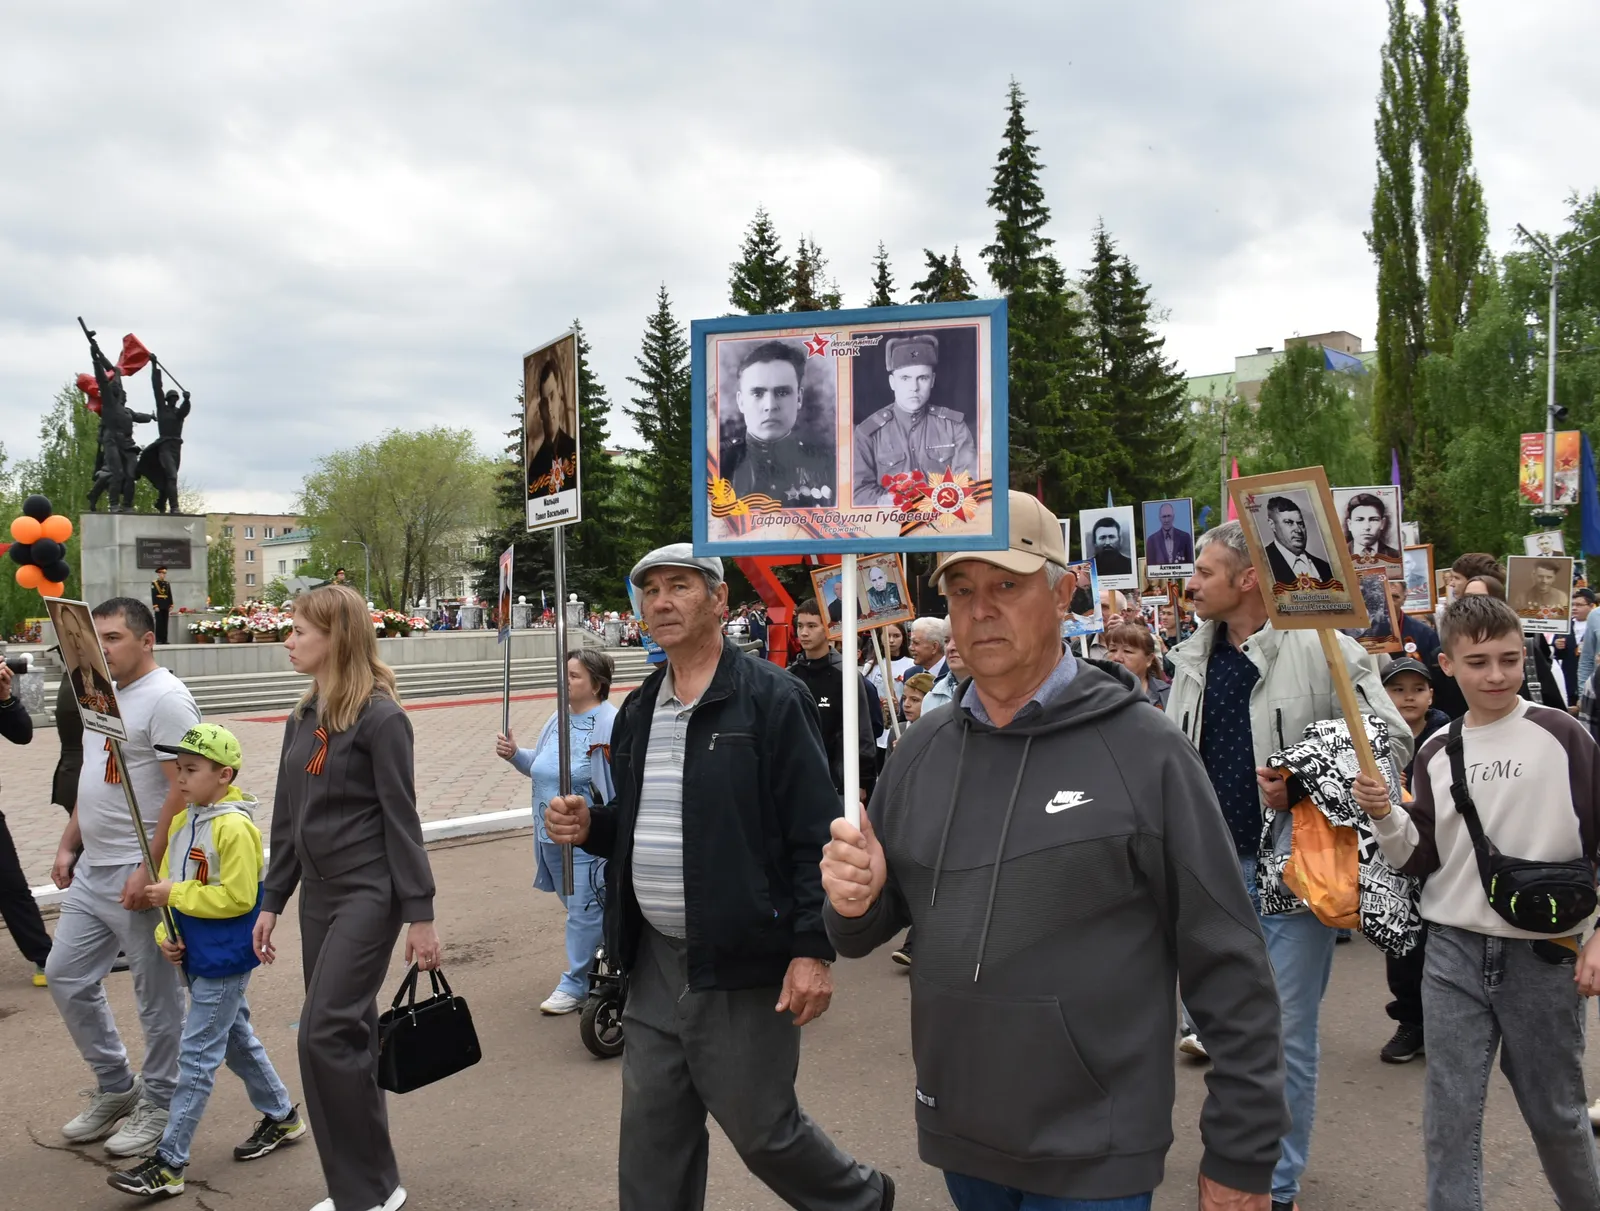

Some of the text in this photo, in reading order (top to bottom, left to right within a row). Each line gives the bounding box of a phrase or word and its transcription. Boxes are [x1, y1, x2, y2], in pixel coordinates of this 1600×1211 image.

[831, 347, 861, 357] ПОЛК
[751, 509, 940, 526] Гафаров Габдулла Губаевич
[1320, 727, 1336, 737] LOW
[1052, 790, 1085, 804] NIKE
